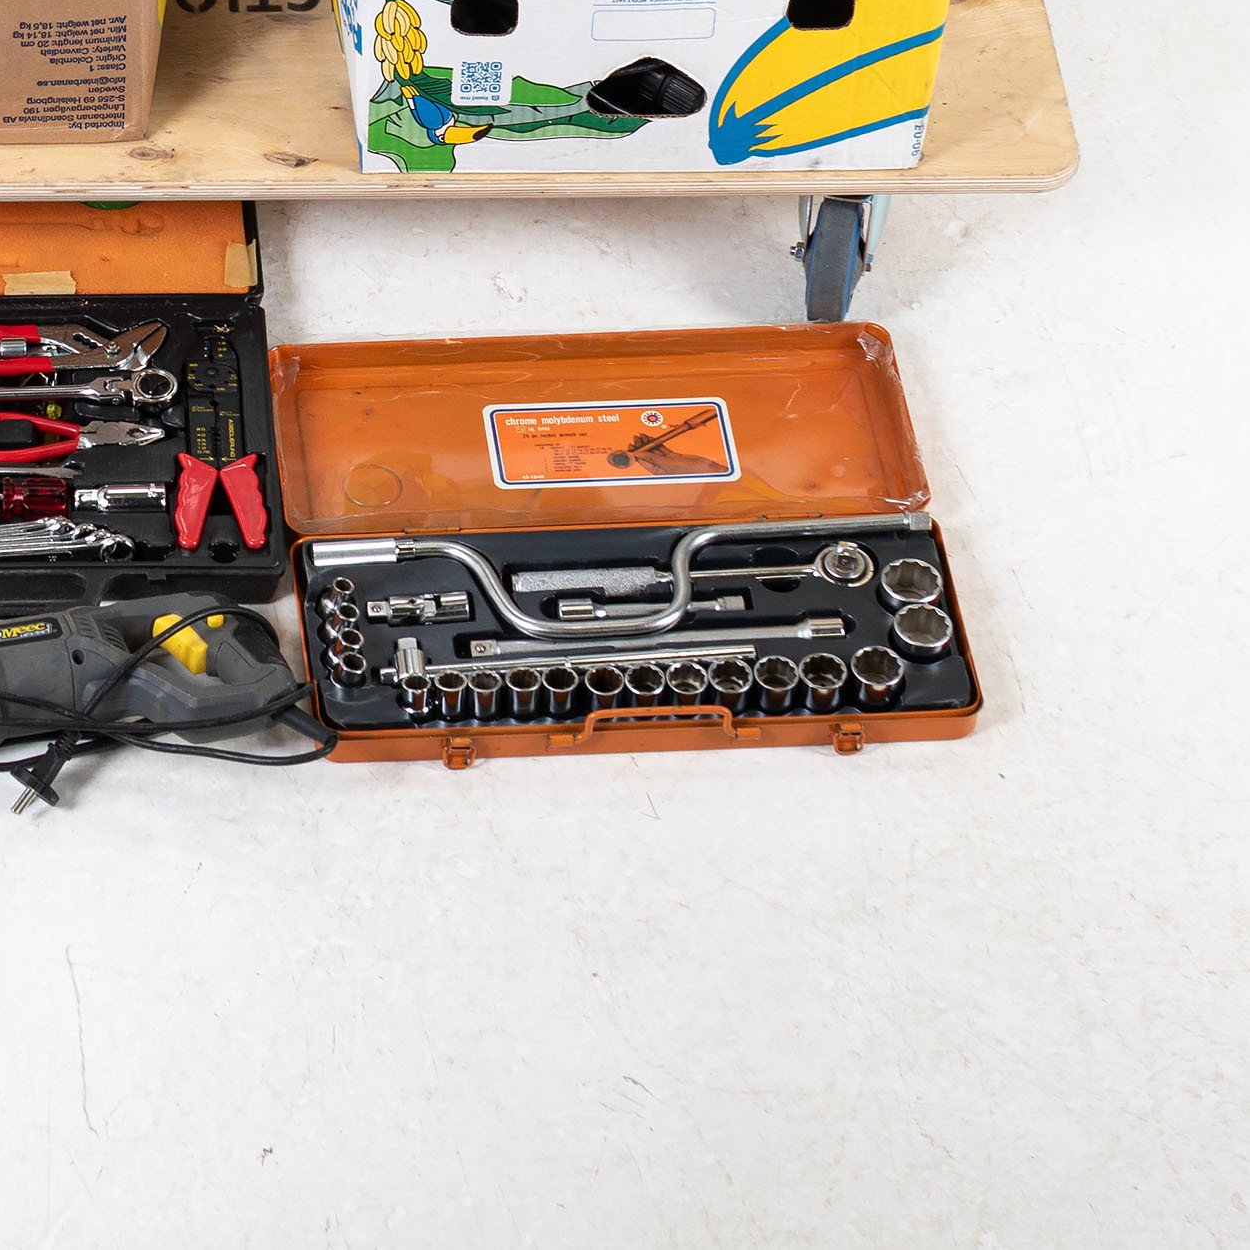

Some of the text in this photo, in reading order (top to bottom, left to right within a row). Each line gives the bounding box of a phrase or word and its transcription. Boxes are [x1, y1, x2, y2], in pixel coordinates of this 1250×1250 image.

[18, 15, 127, 31] Avr. net weight: 18,5 kg
[12, 24, 127, 40] Min. net weight: 18,14 kg
[37, 40, 50, 48] 20
[51, 38, 83, 48] length:
[85, 34, 127, 45] Minimum
[40, 44, 127, 57] Variety: Cavendish
[49, 53, 126, 65] Origin: Colombia
[97, 62, 126, 71] Class:
[88, 85, 126, 94] Sweden
[26, 96, 81, 106] Helsingborg
[97, 94, 126, 103] S-256
[23, 107, 41, 115] 190
[2, 112, 126, 124] Interbanan Scandinavia AB
[68, 121, 126, 130] Imported by:
[504, 413, 620, 427] chrome molybdenum steel
